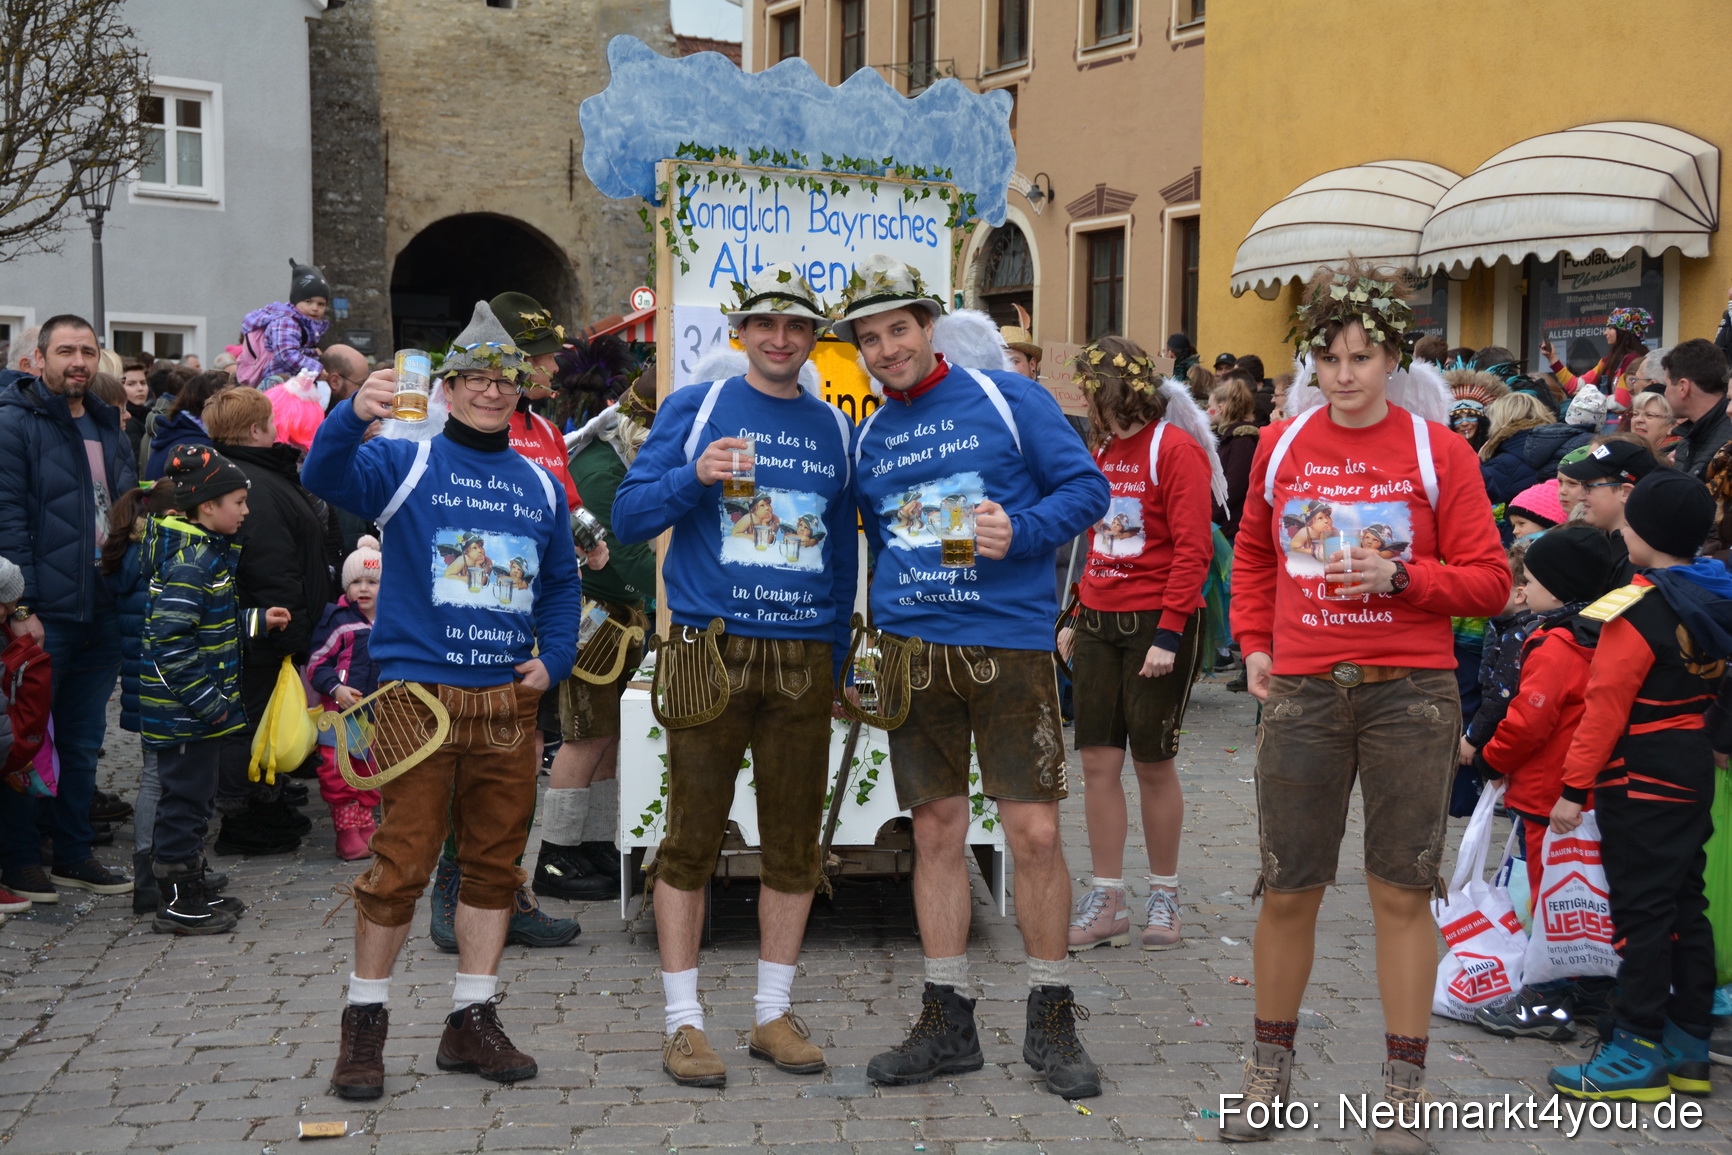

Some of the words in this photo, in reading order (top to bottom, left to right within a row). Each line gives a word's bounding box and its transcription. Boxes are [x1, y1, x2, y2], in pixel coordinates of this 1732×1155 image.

[680, 184, 790, 243] Königlich
[808, 189, 938, 248] Bayrisches
[1595, 291, 1632, 301] Nachmittag
[1549, 329, 1574, 340] ALLEN
[777, 430, 800, 448] des
[805, 437, 817, 450] is
[885, 431, 910, 450] Oans
[914, 422, 937, 437] des
[941, 418, 955, 431] is
[754, 453, 796, 469] immer
[801, 458, 836, 478] gwieß
[872, 458, 895, 478] scho
[897, 446, 934, 468] immer
[939, 434, 980, 459] gwieß
[1116, 460, 1130, 473] des
[1131, 463, 1140, 474] is
[1304, 461, 1339, 477] Oans
[1345, 458, 1366, 475] des
[451, 472, 482, 490] Oans
[488, 475, 509, 492] des
[513, 484, 524, 497] is
[1370, 479, 1413, 499] gwieß
[431, 492, 463, 506] scho
[466, 496, 507, 512] immer
[899, 571, 912, 585] in
[963, 567, 978, 581] is
[732, 585, 750, 599] in
[754, 584, 801, 606] Oening
[803, 591, 814, 604] is
[899, 596, 916, 606] as
[915, 588, 981, 604] Paradies
[757, 607, 818, 622] Paradies
[1302, 613, 1318, 626] as
[1320, 608, 1393, 627] Paradies
[446, 625, 464, 639] in
[468, 624, 514, 646] Oening
[517, 629, 526, 643] is
[446, 651, 464, 664] as
[1550, 846, 1572, 857] BAUEN
[1548, 897, 1608, 913] FERTIGHAUS
[1445, 930, 1457, 941] AUS
[1456, 921, 1474, 936] EINER
[1550, 957, 1567, 966] Tel.
